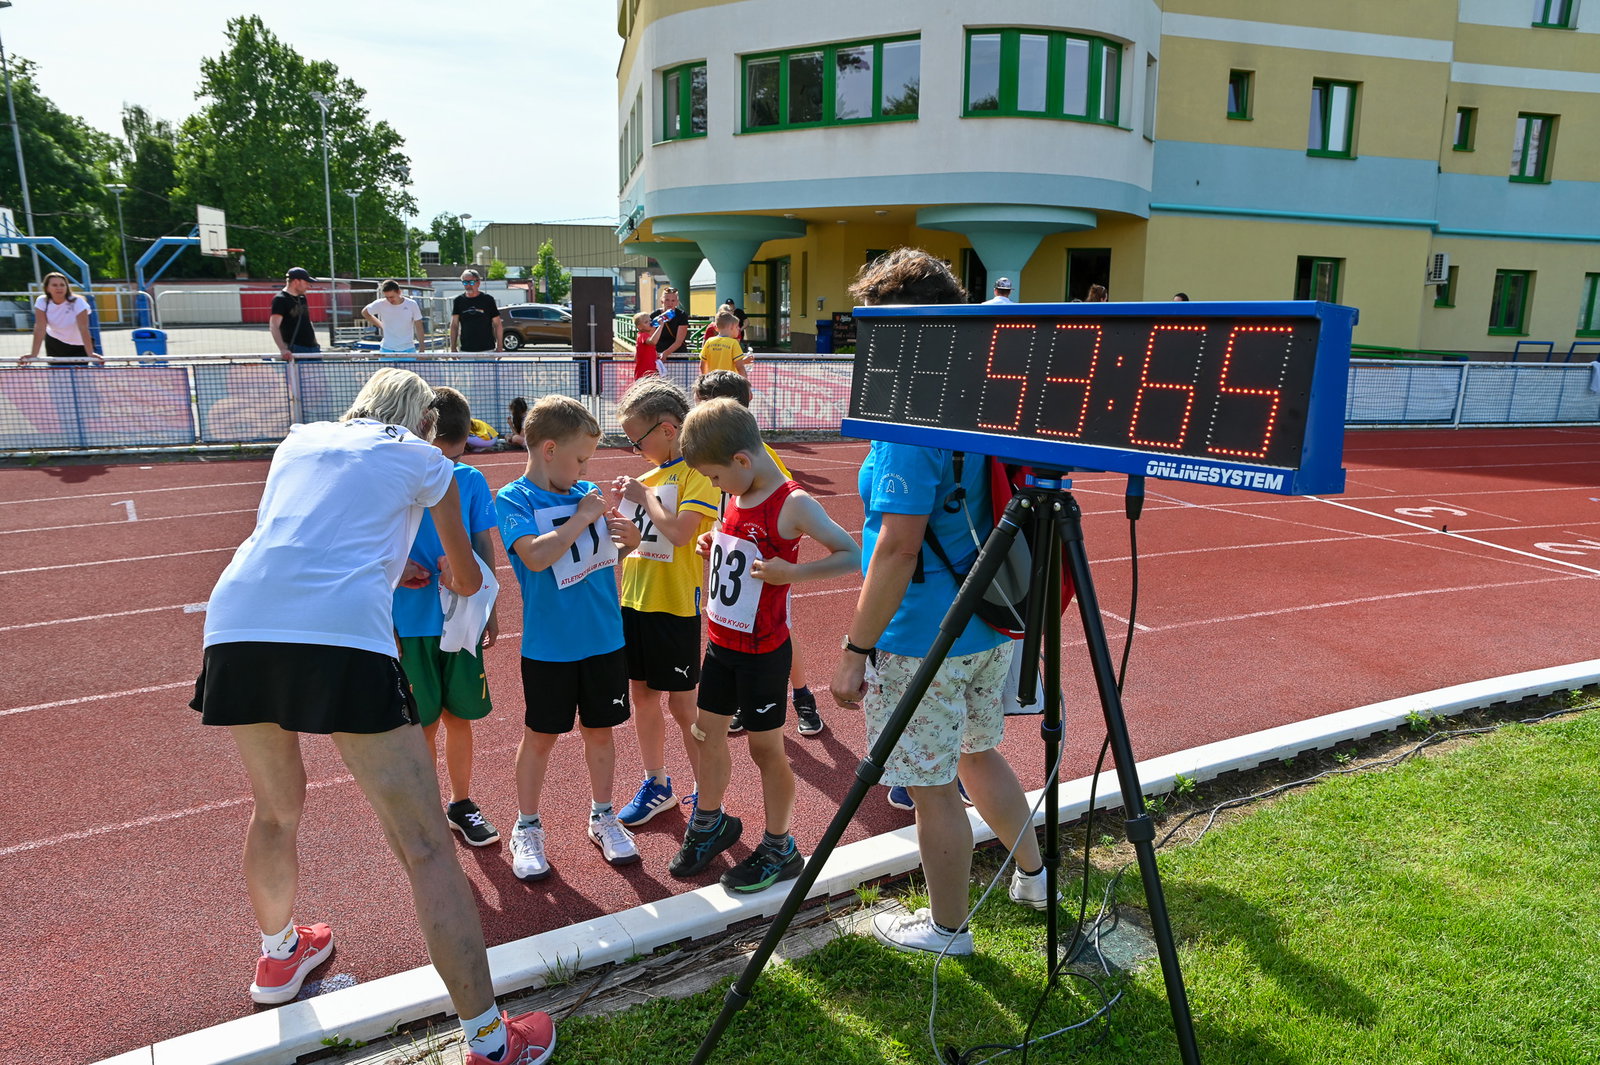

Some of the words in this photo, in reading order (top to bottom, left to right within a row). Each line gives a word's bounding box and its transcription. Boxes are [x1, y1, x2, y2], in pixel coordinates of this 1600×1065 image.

[710, 544, 747, 607] 83
[714, 613, 727, 623] KLUB
[727, 618, 751, 629] KYJOV
